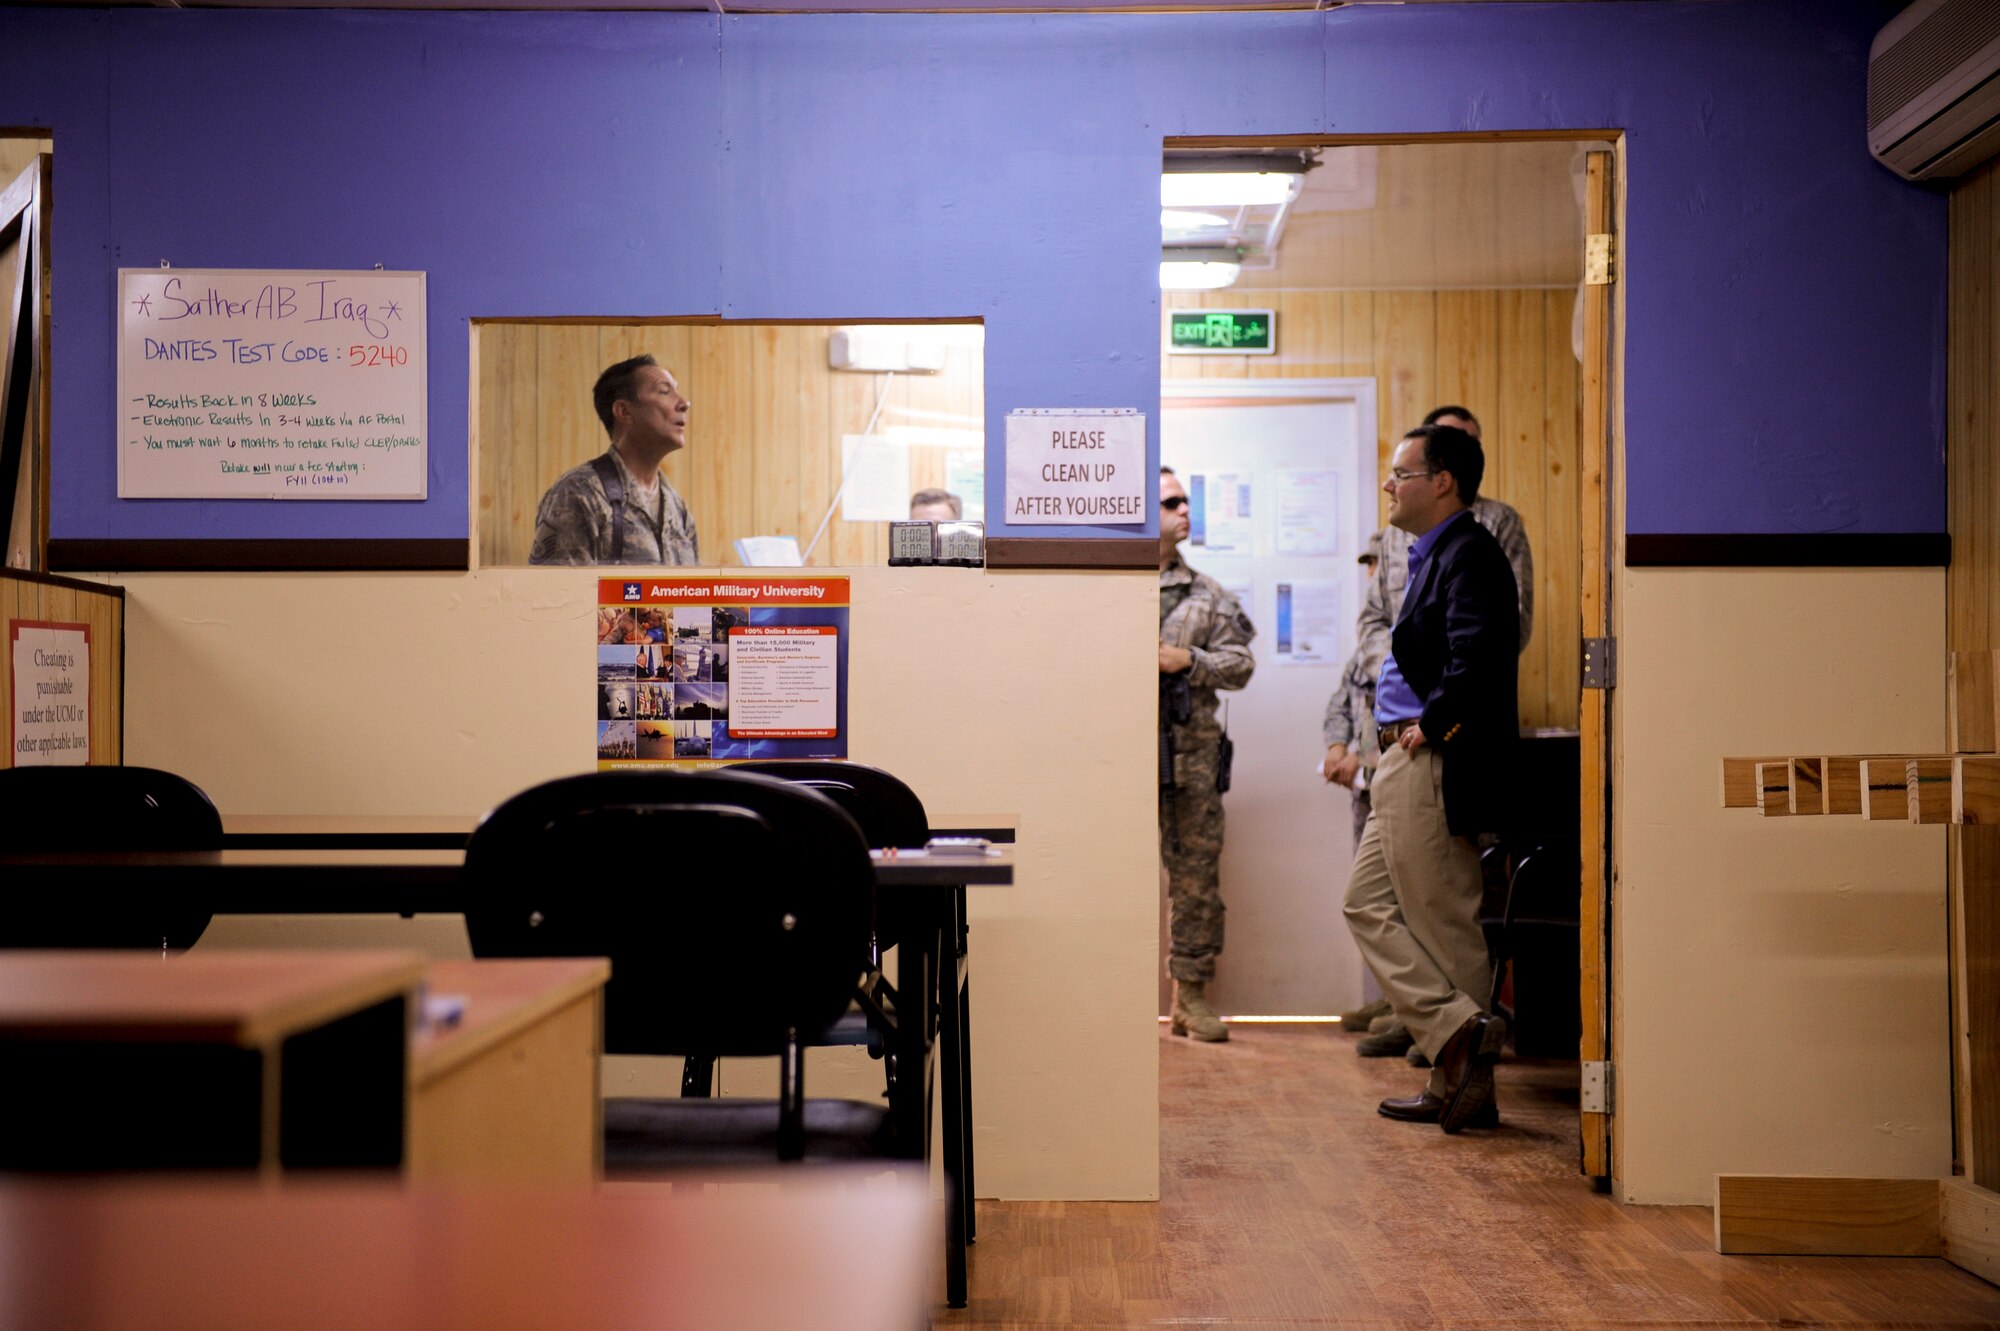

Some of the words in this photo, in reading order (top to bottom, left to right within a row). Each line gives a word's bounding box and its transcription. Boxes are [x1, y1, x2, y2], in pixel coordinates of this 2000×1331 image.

[158, 278, 252, 320] Sather
[256, 285, 298, 319] AB
[304, 280, 389, 339] Iraq
[1173, 323, 1207, 340] EXIT
[145, 338, 218, 360] DANTES
[222, 339, 276, 363] TEST
[350, 345, 407, 367] 5240
[200, 394, 238, 408] Back
[258, 393, 267, 407] 8
[143, 415, 205, 427] Electronic
[209, 413, 253, 426] Results
[278, 415, 301, 427] 3-4
[144, 435, 162, 449] You
[167, 437, 195, 448] must
[199, 437, 221, 447] wait
[227, 437, 236, 447] 6
[241, 437, 279, 448] months
[283, 437, 294, 448] to
[298, 438, 327, 448] retake
[1052, 431, 1105, 449] PLEASE
[253, 463, 271, 474] will
[307, 461, 323, 471] fee
[1042, 464, 1089, 482] CLEAN
[1095, 464, 1115, 482] UP
[1015, 497, 1062, 515] AFTER
[1066, 496, 1141, 515] YOURSELF
[650, 585, 710, 597] American
[713, 585, 760, 599] Military
[763, 585, 825, 599] University
[34, 649, 67, 672] Cheating
[68, 650, 74, 667] is
[36, 677, 73, 699] punishable
[22, 705, 44, 723] under
[45, 705, 55, 722] the
[56, 705, 76, 722] UCMJ
[77, 709, 84, 721] or
[17, 734, 37, 753] other
[39, 732, 71, 756] applicable
[73, 731, 87, 749] laws.
